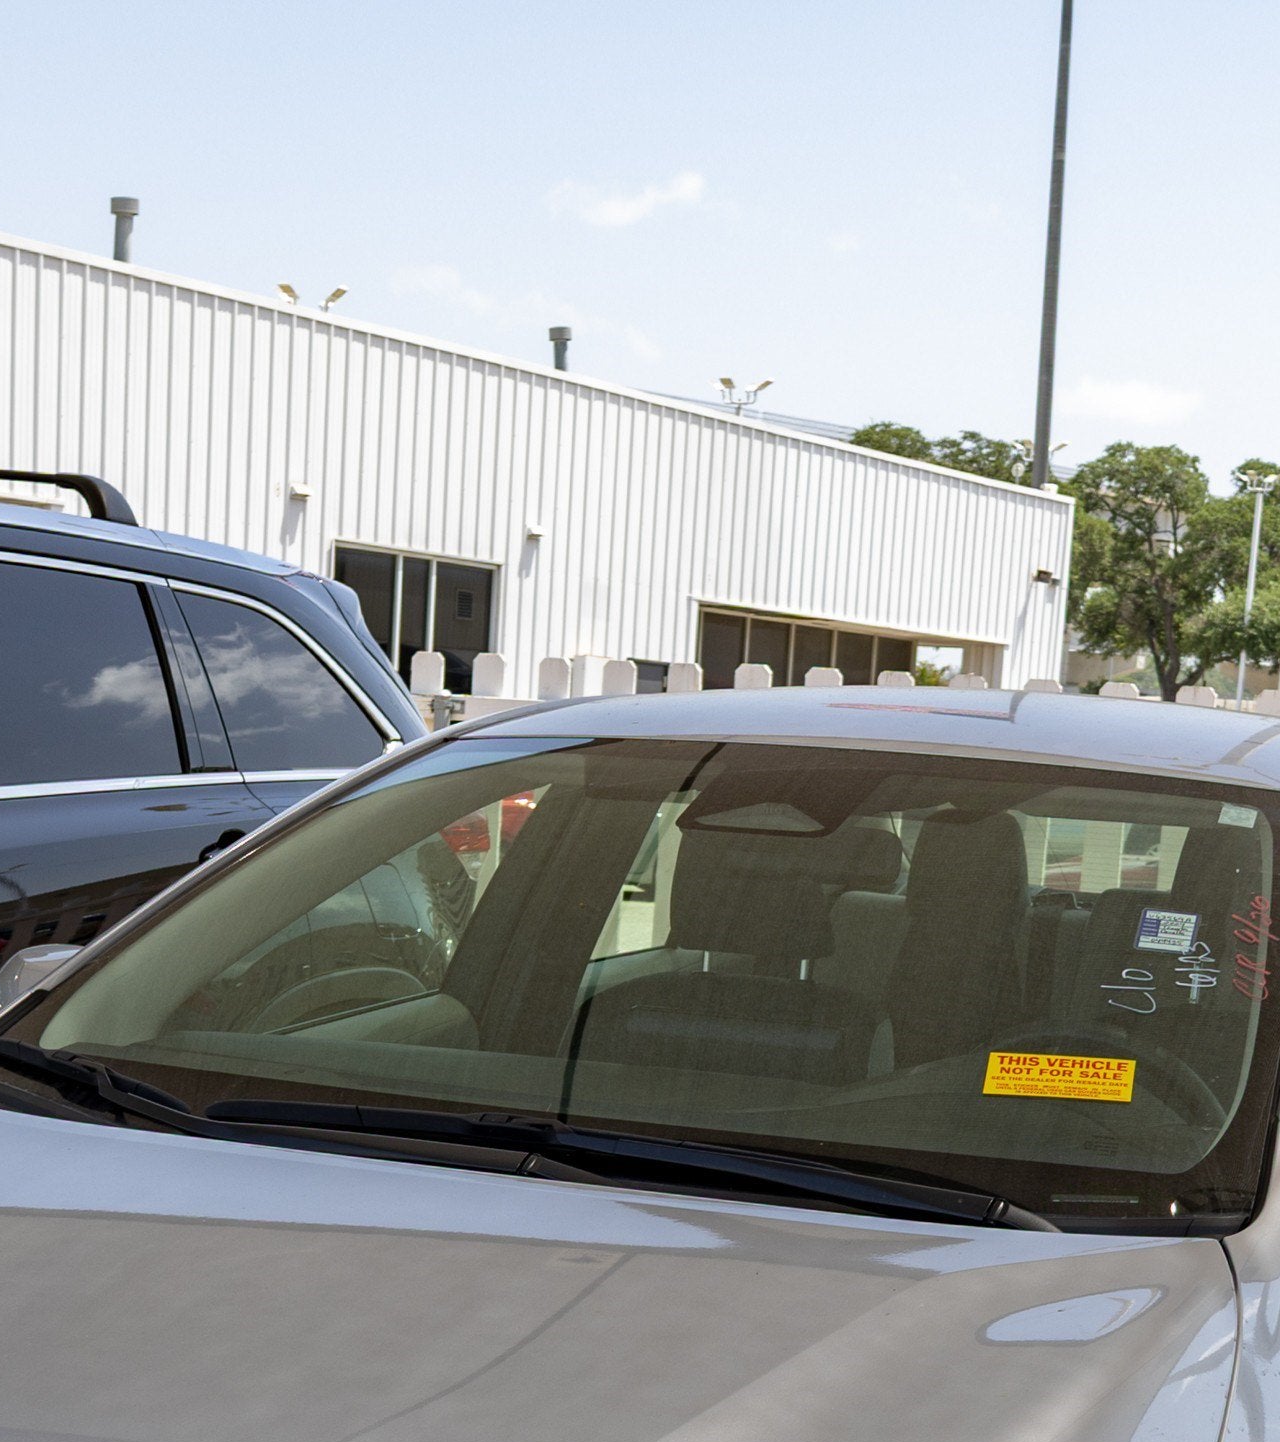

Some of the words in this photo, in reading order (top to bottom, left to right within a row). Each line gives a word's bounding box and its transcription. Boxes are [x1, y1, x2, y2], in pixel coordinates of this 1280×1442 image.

[997, 1055, 1040, 1067] THIS
[1046, 1057, 1130, 1073] VEHICLE
[999, 1066, 1034, 1075] NOT
[1038, 1068, 1074, 1078] FOR
[1078, 1070, 1124, 1081] SALE
